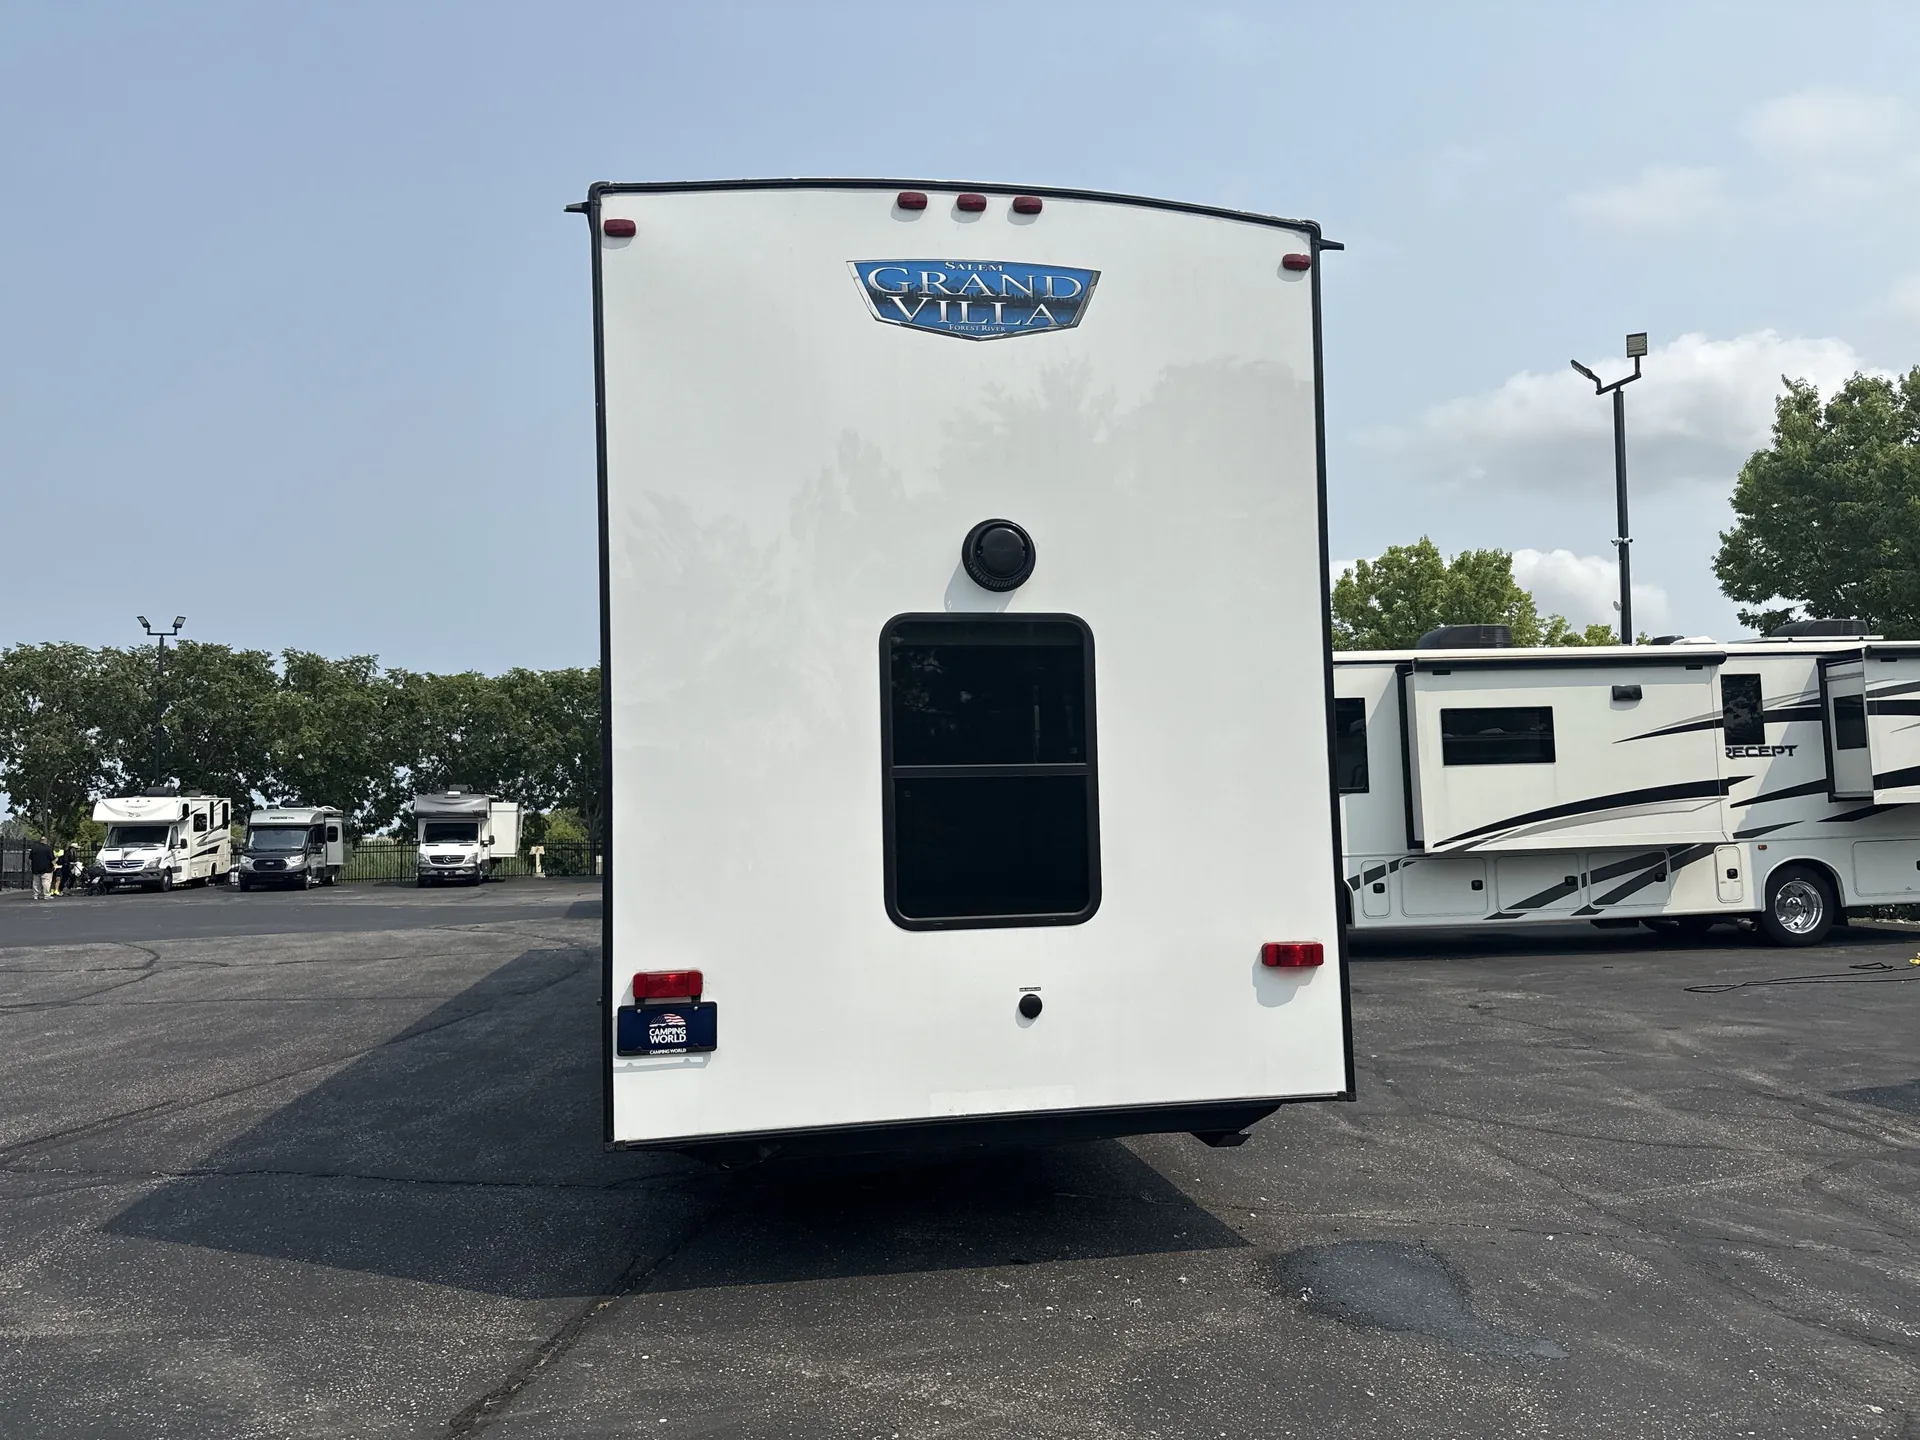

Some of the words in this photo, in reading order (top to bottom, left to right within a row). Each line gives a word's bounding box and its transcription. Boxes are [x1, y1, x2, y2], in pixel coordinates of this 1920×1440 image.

[945, 261, 1003, 272] SALEM
[867, 267, 1082, 299] GRAND
[886, 295, 1062, 326] VILLA
[981, 324, 1006, 332] RIVER
[649, 1027, 686, 1036] CAMPING
[650, 1034, 687, 1044] WORLD
